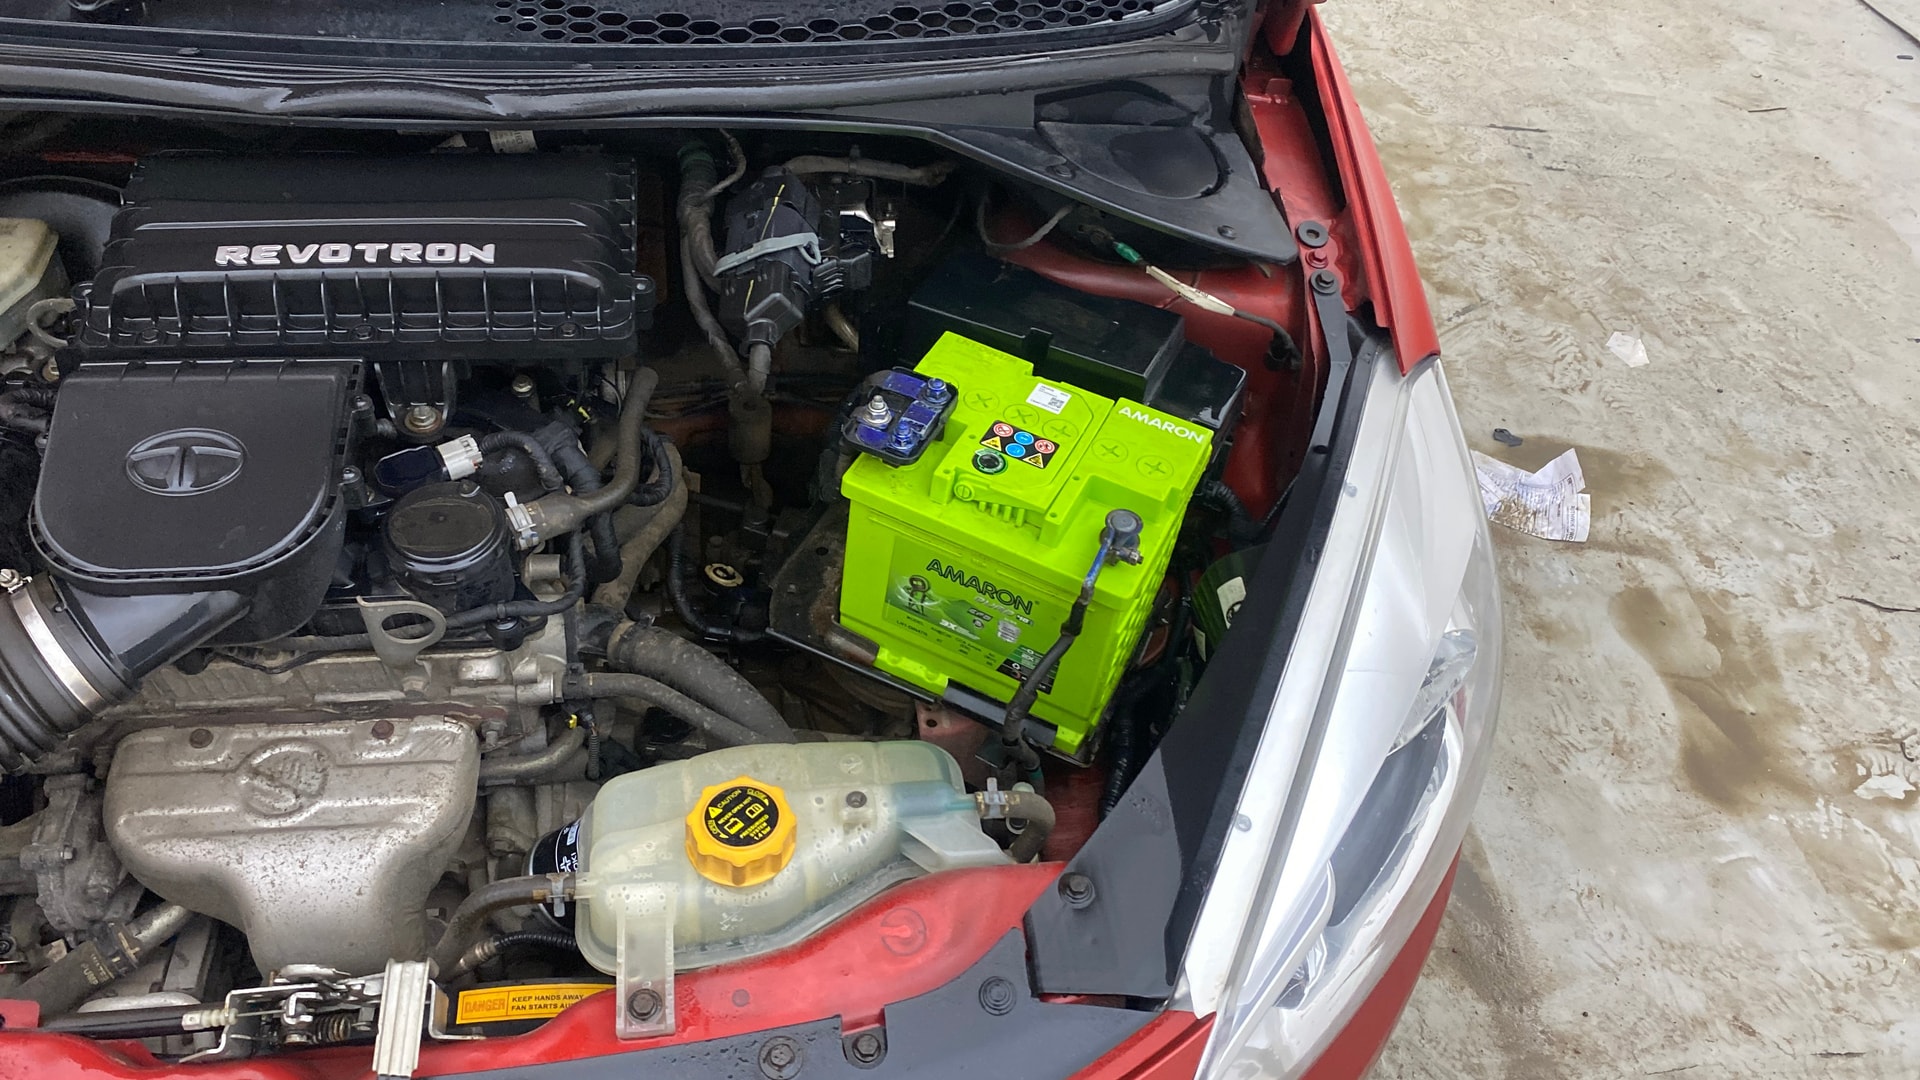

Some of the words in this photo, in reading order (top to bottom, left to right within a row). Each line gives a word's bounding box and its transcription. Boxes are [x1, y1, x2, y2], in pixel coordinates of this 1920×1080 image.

[214, 242, 497, 266] REVOTRON
[1118, 406, 1205, 444] AMARON
[926, 558, 1034, 615] AMARON
[717, 788, 742, 808] CAUTION
[718, 811, 733, 824] NEVER
[731, 803, 745, 814] OPEN
[749, 822, 768, 837] SYSTEM
[464, 998, 506, 1013] DANGER
